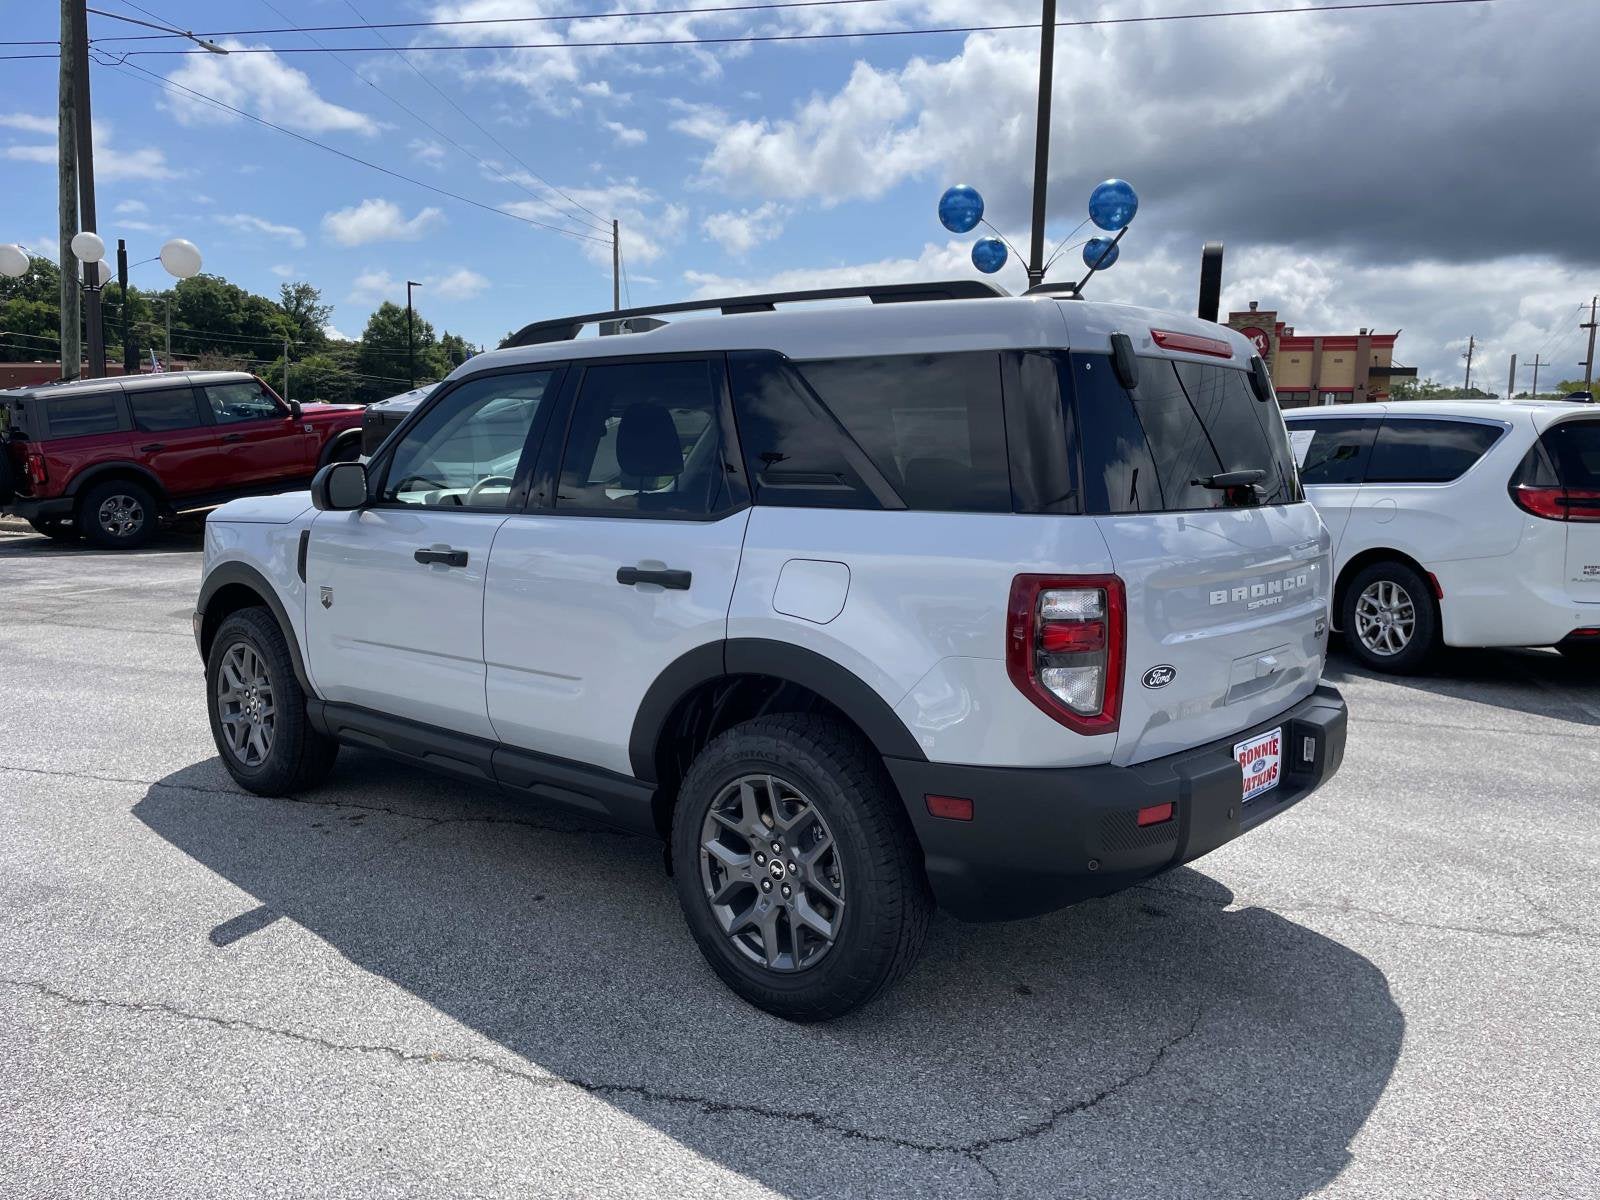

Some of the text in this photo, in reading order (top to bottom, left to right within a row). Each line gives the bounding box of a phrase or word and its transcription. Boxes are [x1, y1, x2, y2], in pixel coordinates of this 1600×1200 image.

[1209, 574, 1307, 605] BRONCO
[1247, 595, 1283, 610] SPORT
[1148, 668, 1174, 686] Ford
[1239, 738, 1278, 768] RONNIE
